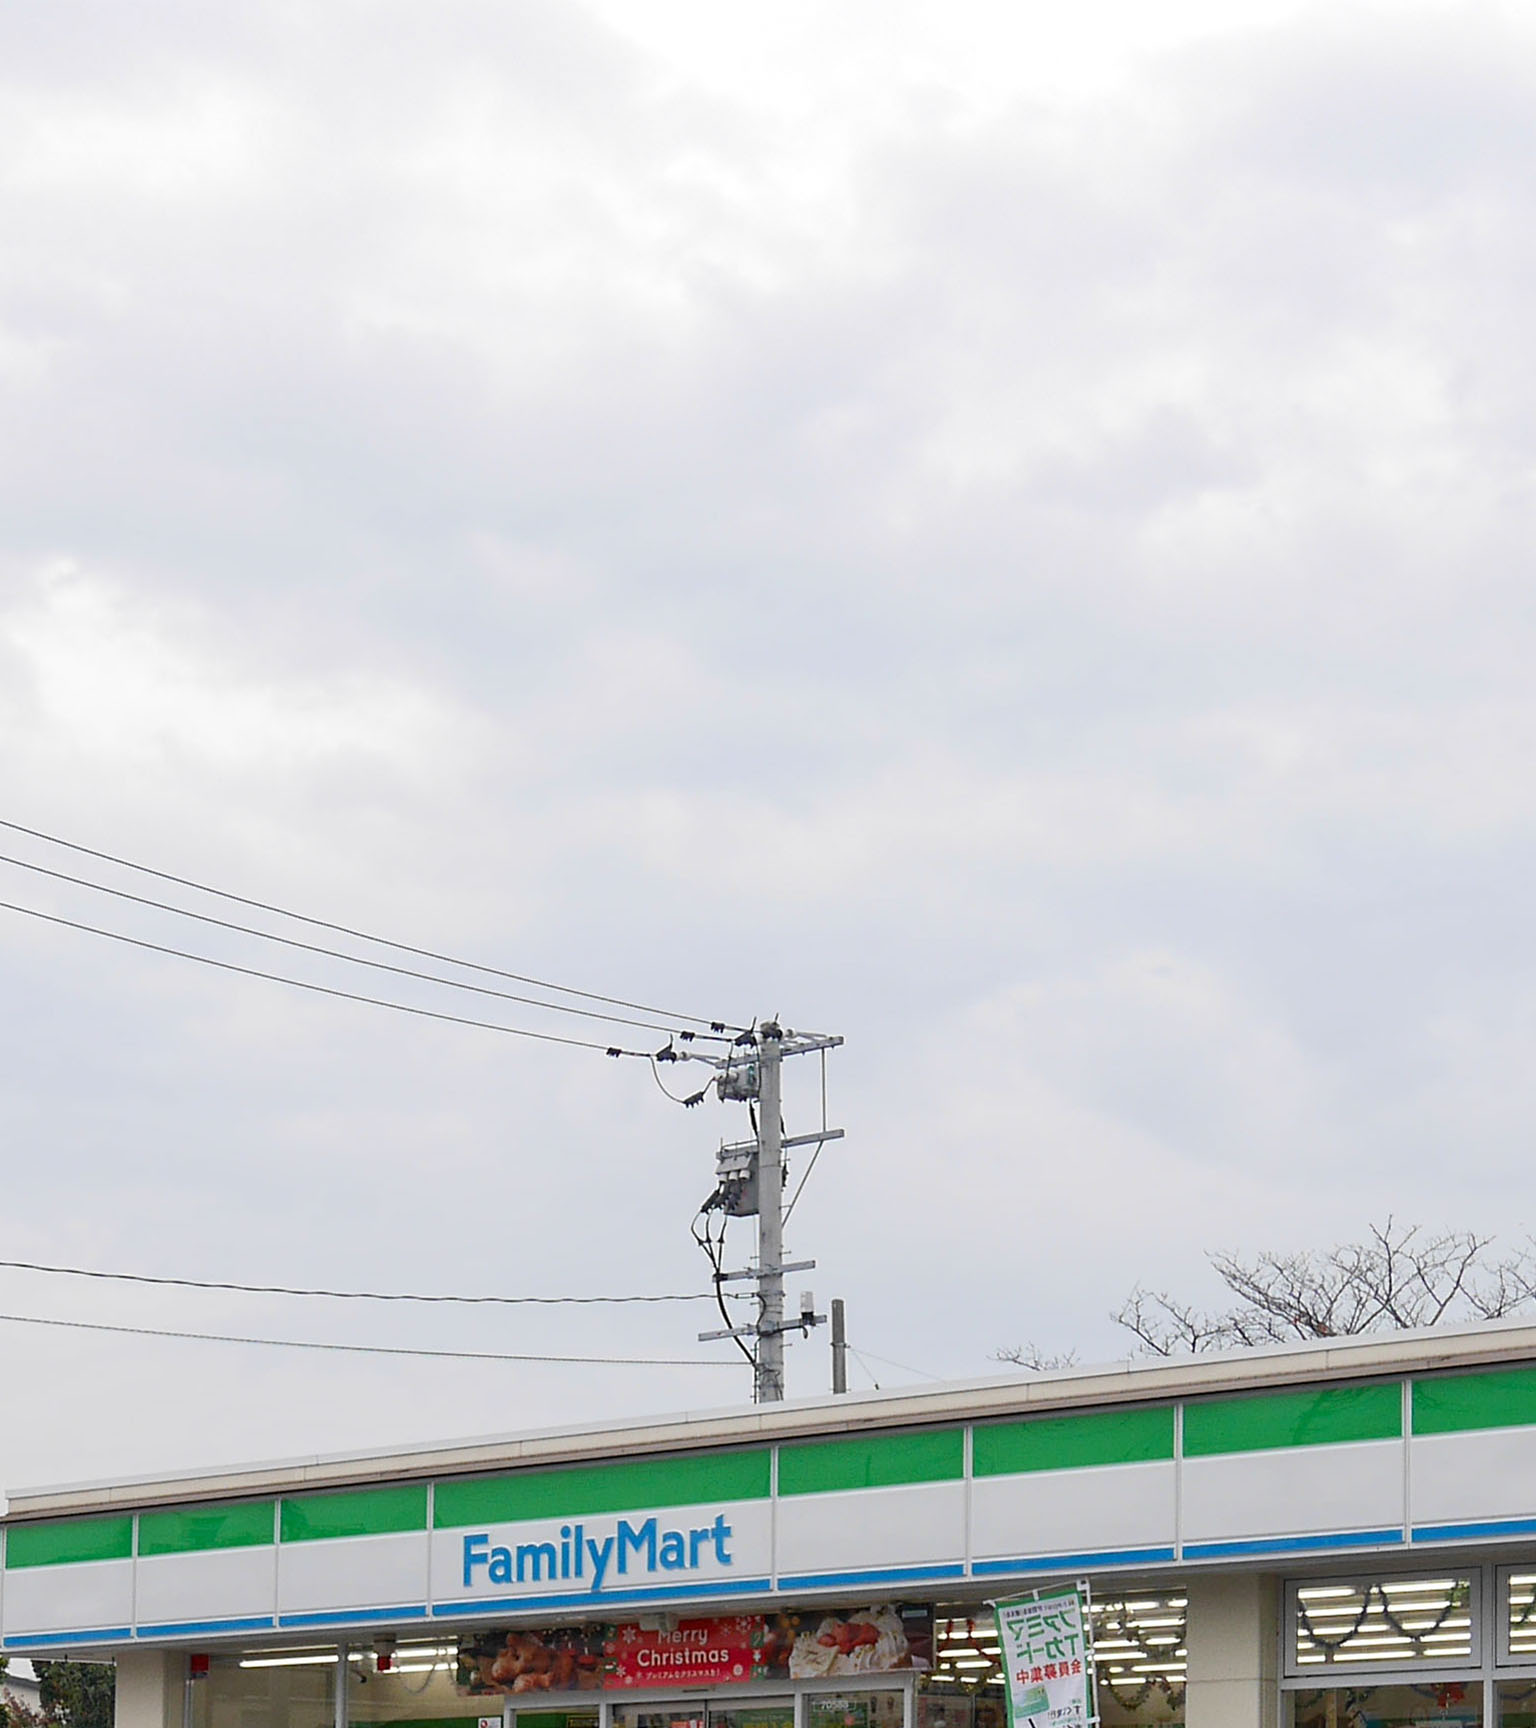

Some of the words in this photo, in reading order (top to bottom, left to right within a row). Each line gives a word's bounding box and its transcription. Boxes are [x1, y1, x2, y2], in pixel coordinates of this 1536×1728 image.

[463, 1514, 733, 1593] FamilyMart
[658, 1629, 708, 1646] Merry
[637, 1648, 729, 1667] Christmas
